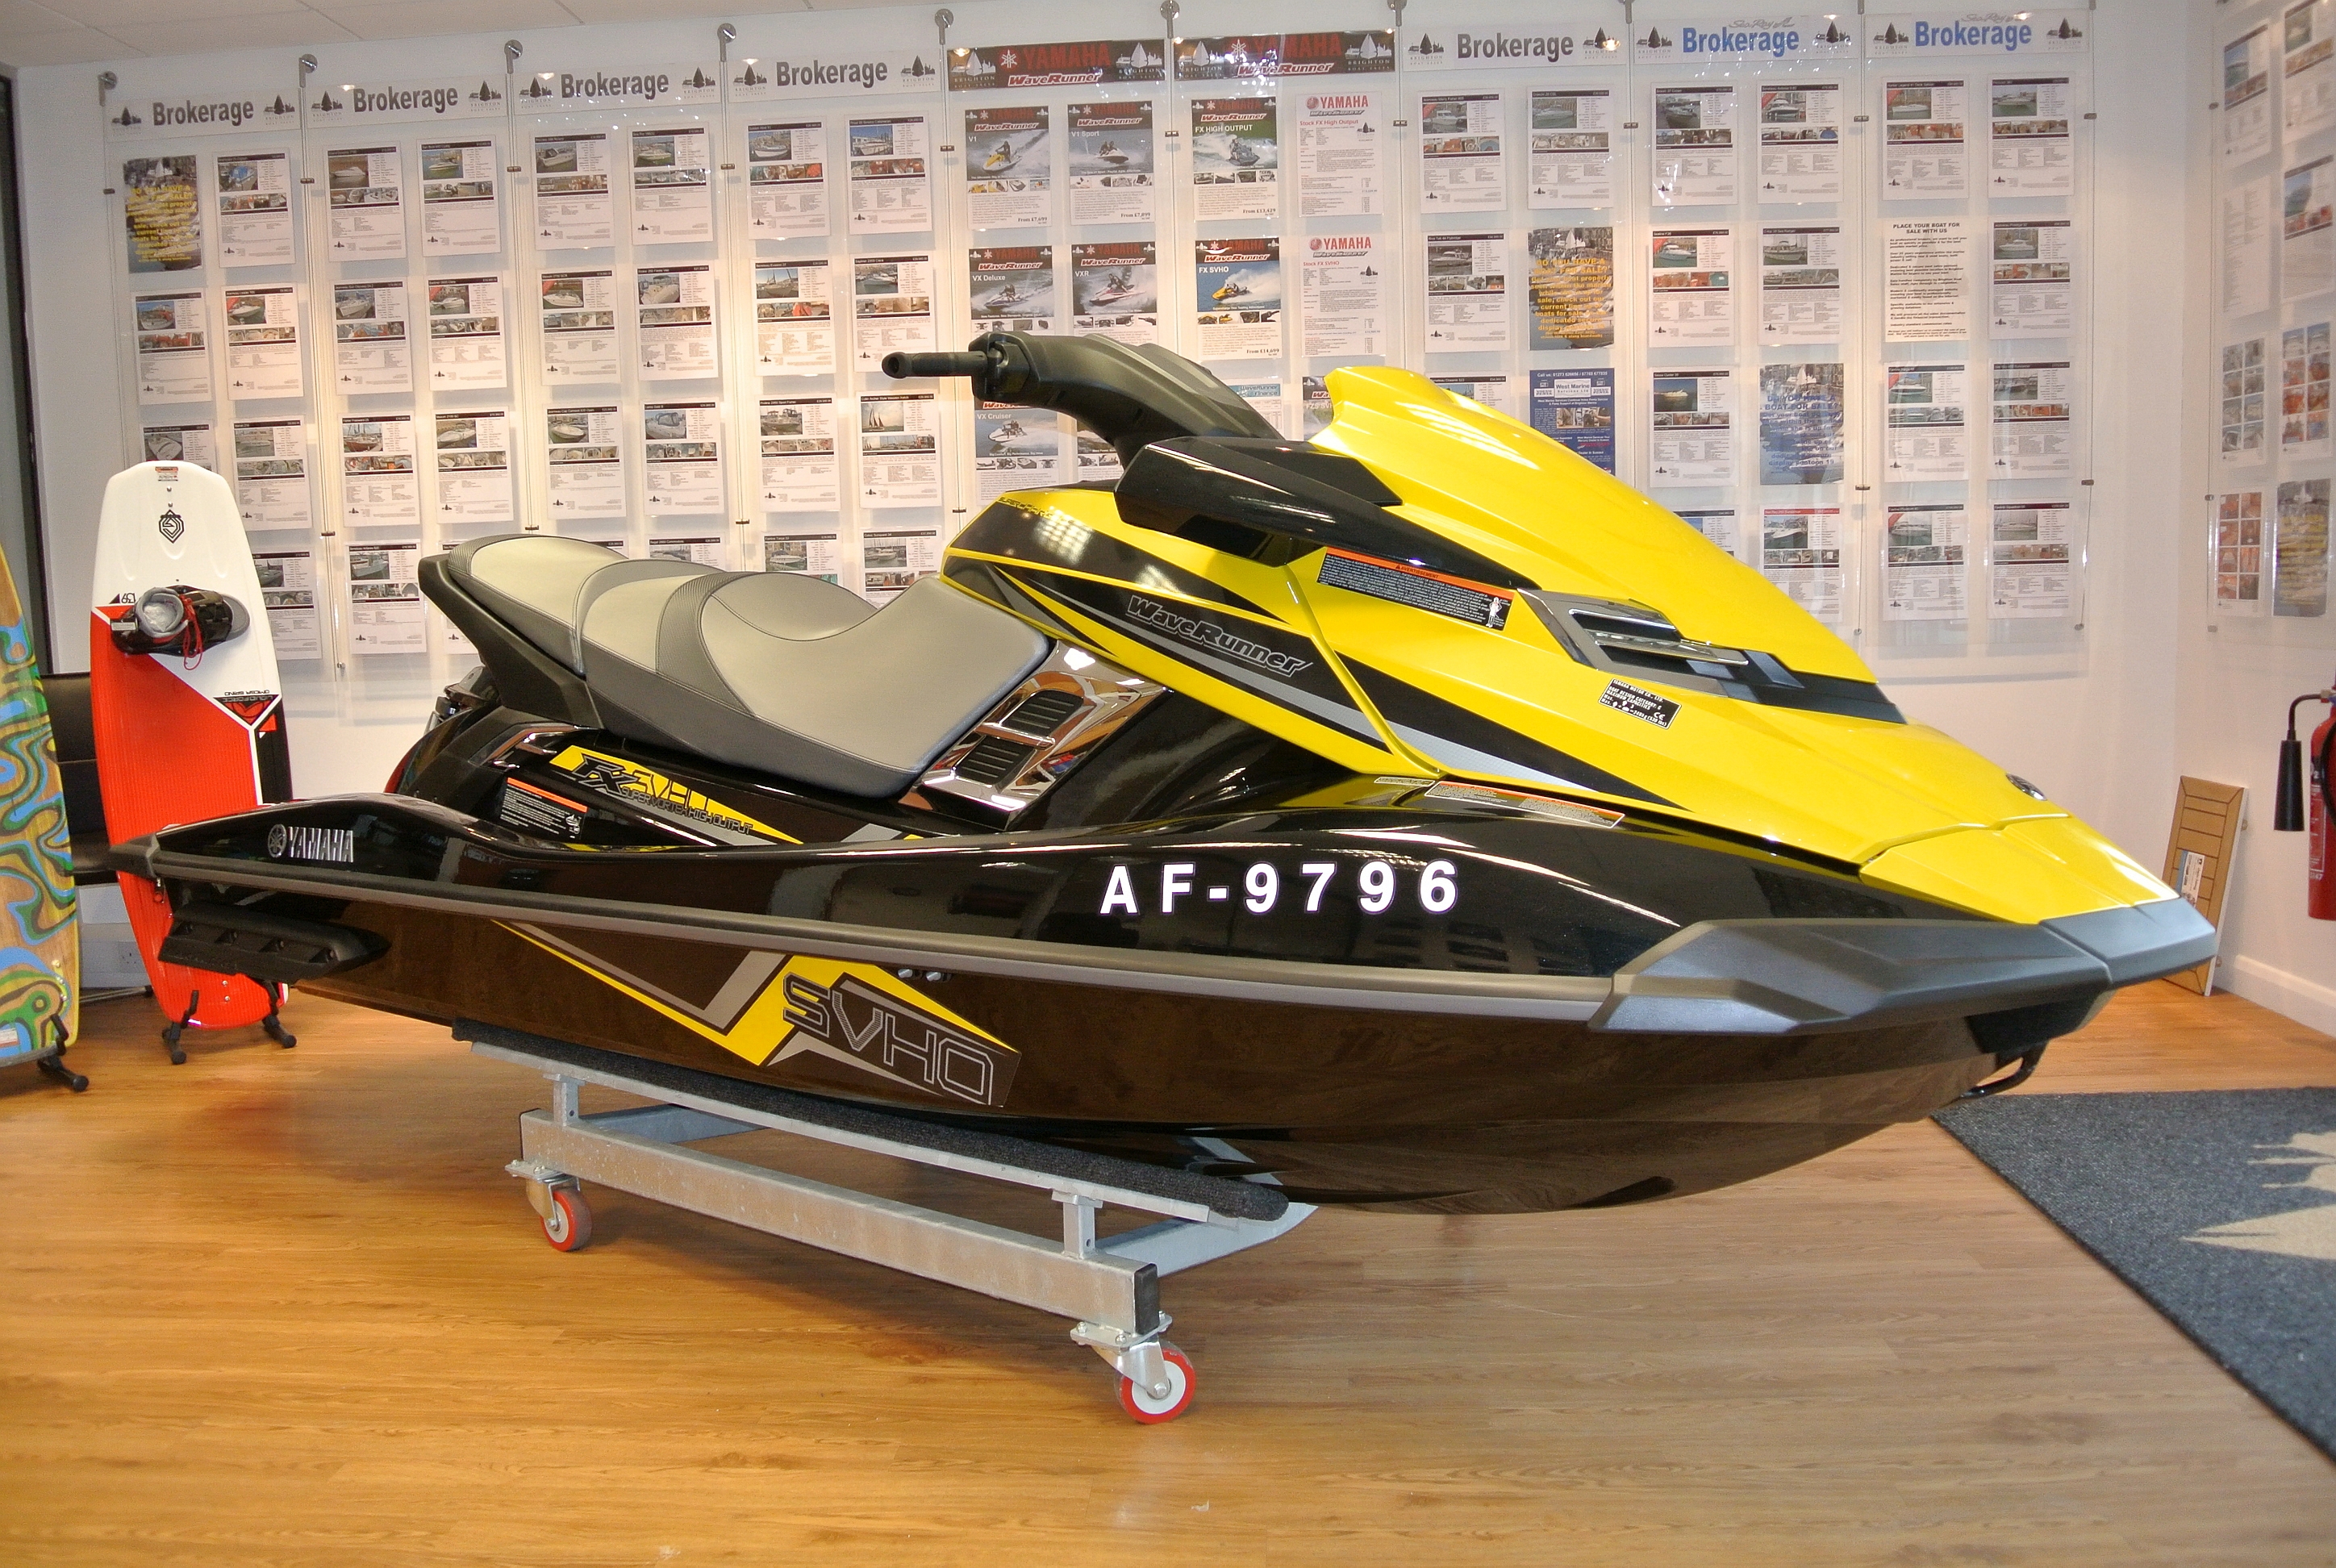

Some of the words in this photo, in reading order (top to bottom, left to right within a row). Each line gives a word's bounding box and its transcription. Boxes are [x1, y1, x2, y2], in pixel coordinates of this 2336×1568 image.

[1683, 27, 1799, 57] Brokerage
[1915, 20, 2032, 51] Brokerage
[1023, 44, 1111, 69] YAMAHA
[1458, 32, 1574, 62] Brokerage
[777, 60, 887, 89] Brokerage
[1007, 73, 1103, 86] WaveRunner
[1237, 62, 1334, 77] WaveRunner
[561, 72, 670, 99] Brokerage
[353, 85, 458, 114] Brokerage
[1320, 95, 1369, 109] YAMAHA
[152, 100, 254, 127] Brokerage
[1077, 117, 1142, 127] WaveRunner
[1201, 113, 1267, 122] WaveRunner
[974, 122, 1039, 131] WaveRunner
[1081, 131, 1100, 139] Sport
[1324, 236, 1372, 250] YAMAHA
[978, 261, 1043, 270] WaveRunner
[1081, 257, 1146, 266] WaveRunner
[1204, 253, 1270, 262] WaveRunner
[1125, 595, 1314, 678] WaveRunner
[1629, 685, 1645, 694] MOTOR
[621, 787, 652, 804] SUPER
[649, 794, 689, 816] VORTEX
[712, 813, 753, 835] OUTPUT
[288, 826, 353, 862] YAMAHA
[782, 971, 994, 1106] SVHO
